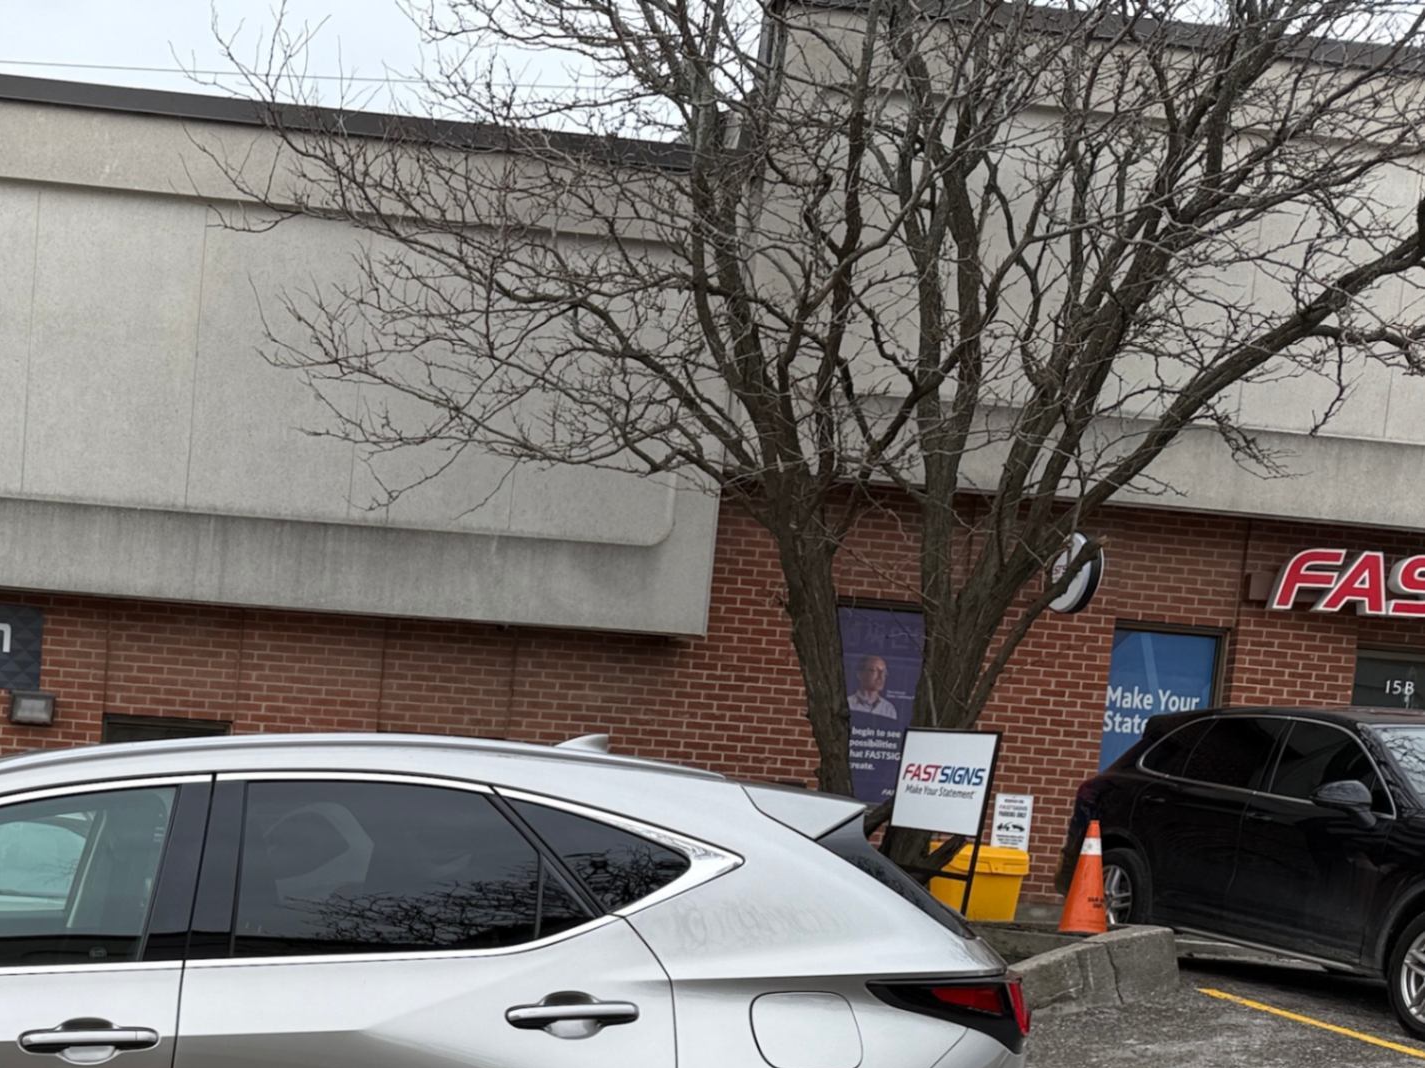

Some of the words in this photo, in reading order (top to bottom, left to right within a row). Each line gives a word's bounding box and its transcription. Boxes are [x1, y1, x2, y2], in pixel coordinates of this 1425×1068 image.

[1105, 685, 1154, 710] Make
[1158, 688, 1200, 712] Your
[851, 726, 875, 737] begin
[876, 729, 885, 738] to
[887, 730, 902, 739] see
[902, 763, 986, 786] FASTSIGNS
[905, 784, 923, 795] Make
[924, 785, 938, 796] Your
[939, 786, 975, 800] Statement
